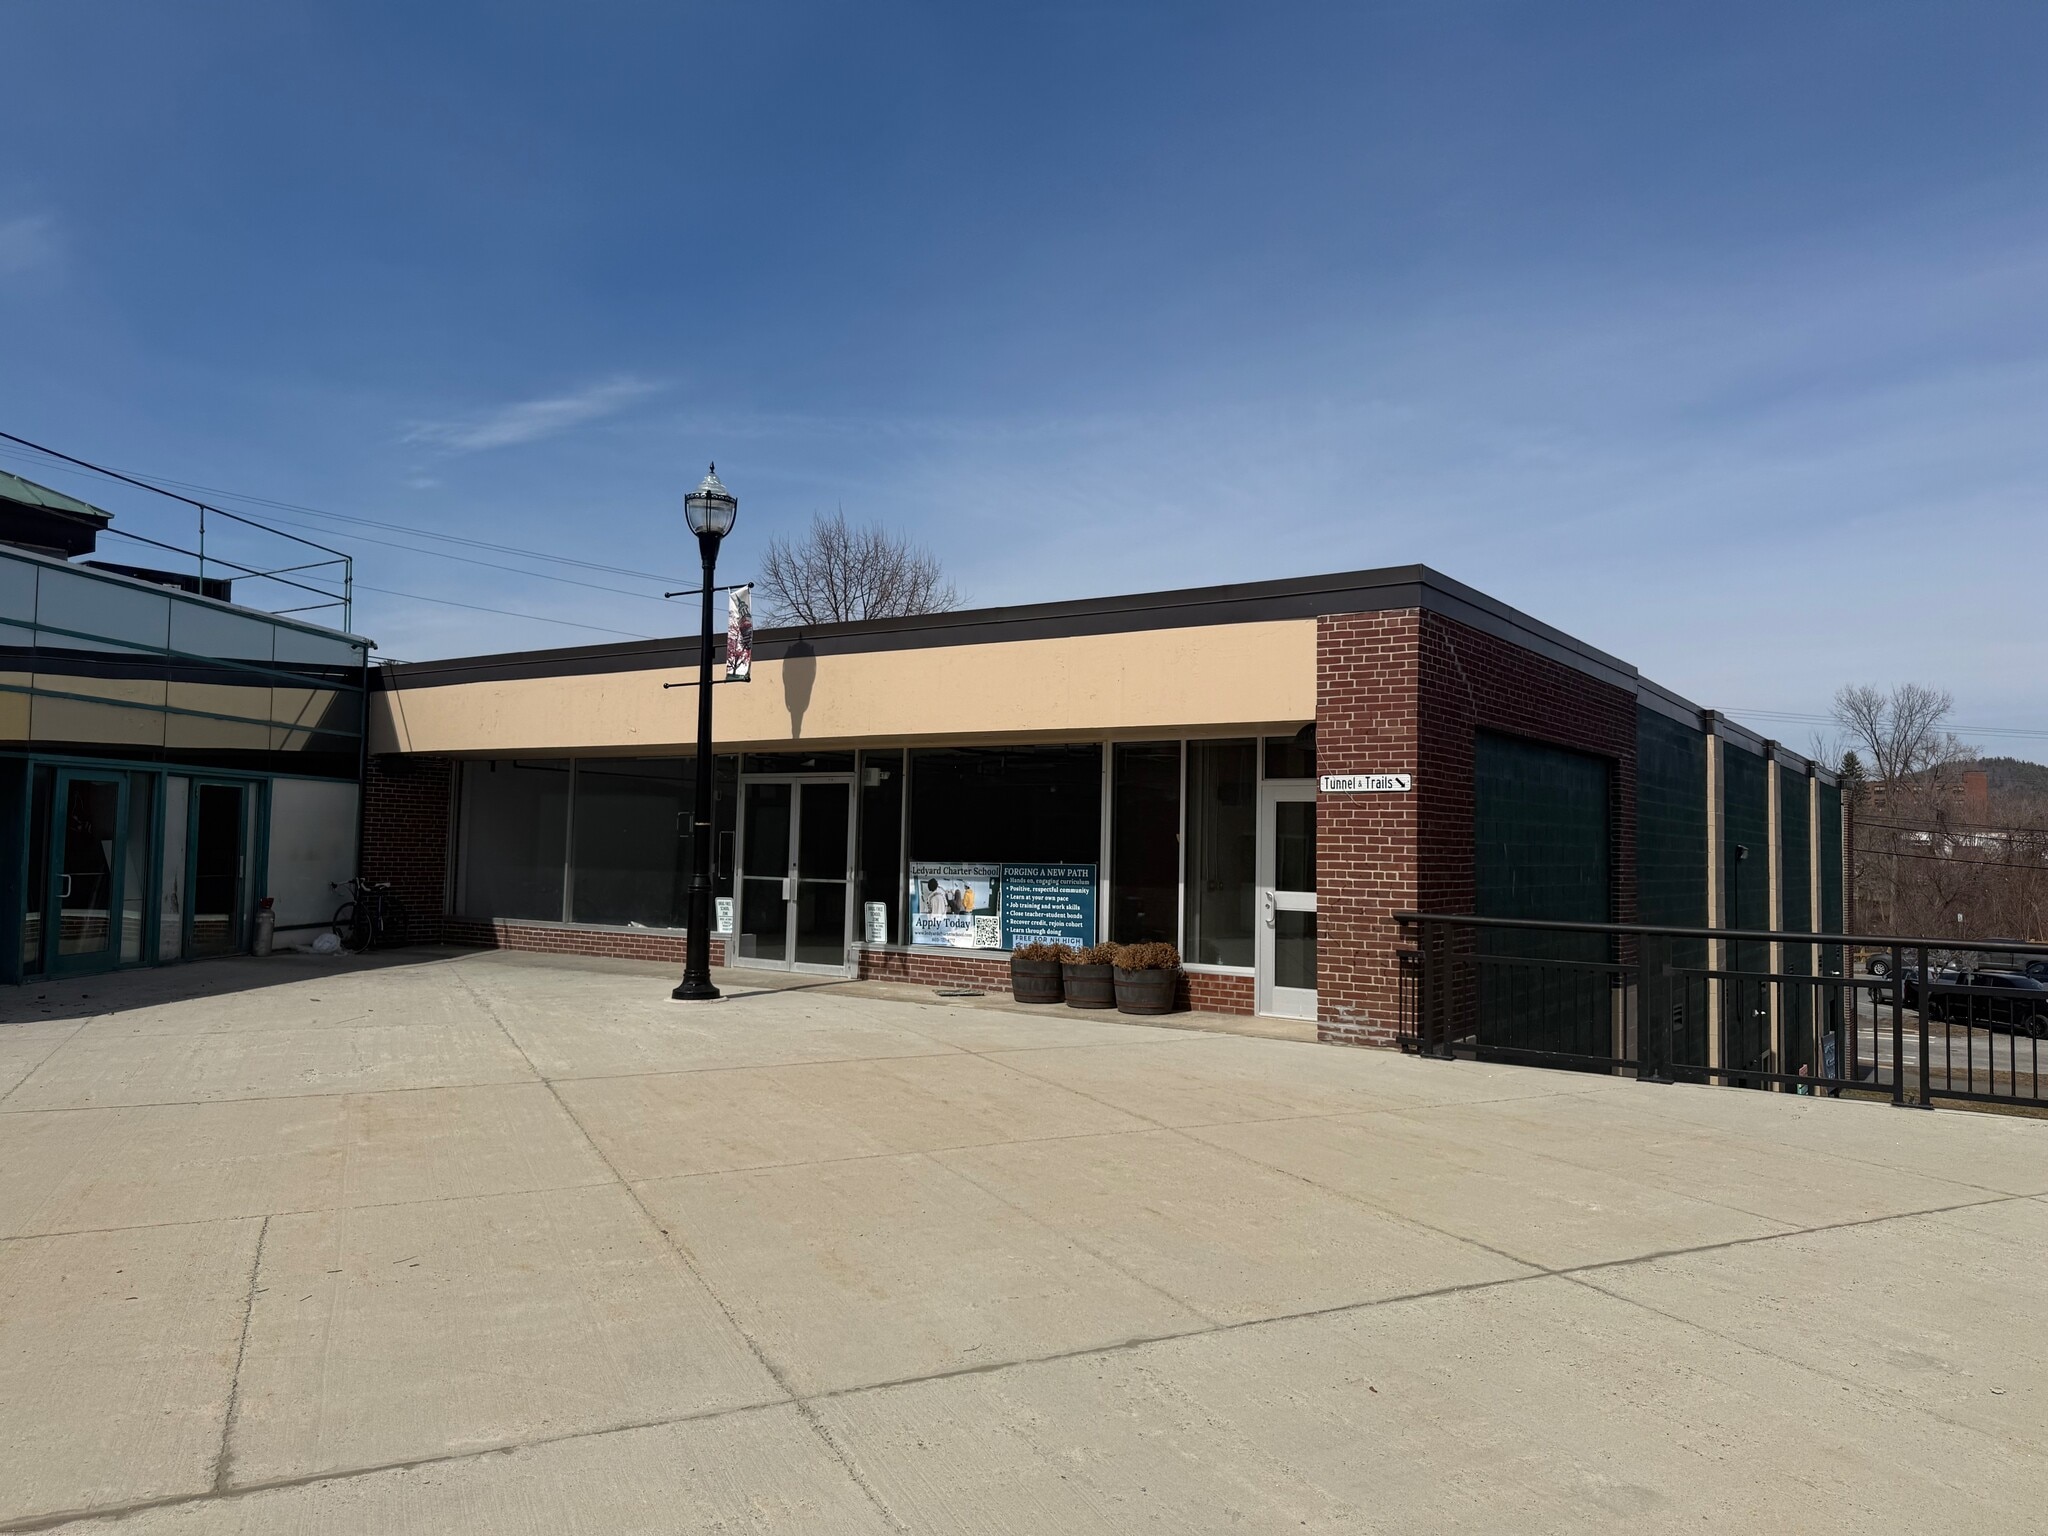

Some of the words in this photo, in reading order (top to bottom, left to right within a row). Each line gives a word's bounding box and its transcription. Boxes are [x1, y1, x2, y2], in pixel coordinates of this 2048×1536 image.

[1324, 777, 1355, 789] Tunnel
[1365, 776, 1392, 789] Trails
[911, 866, 941, 876] Ledyard
[943, 867, 972, 875] Charter
[974, 867, 998, 875] School
[1004, 868, 1038, 876] FORGING
[916, 918, 941, 929] Apply
[943, 918, 970, 931] Today
